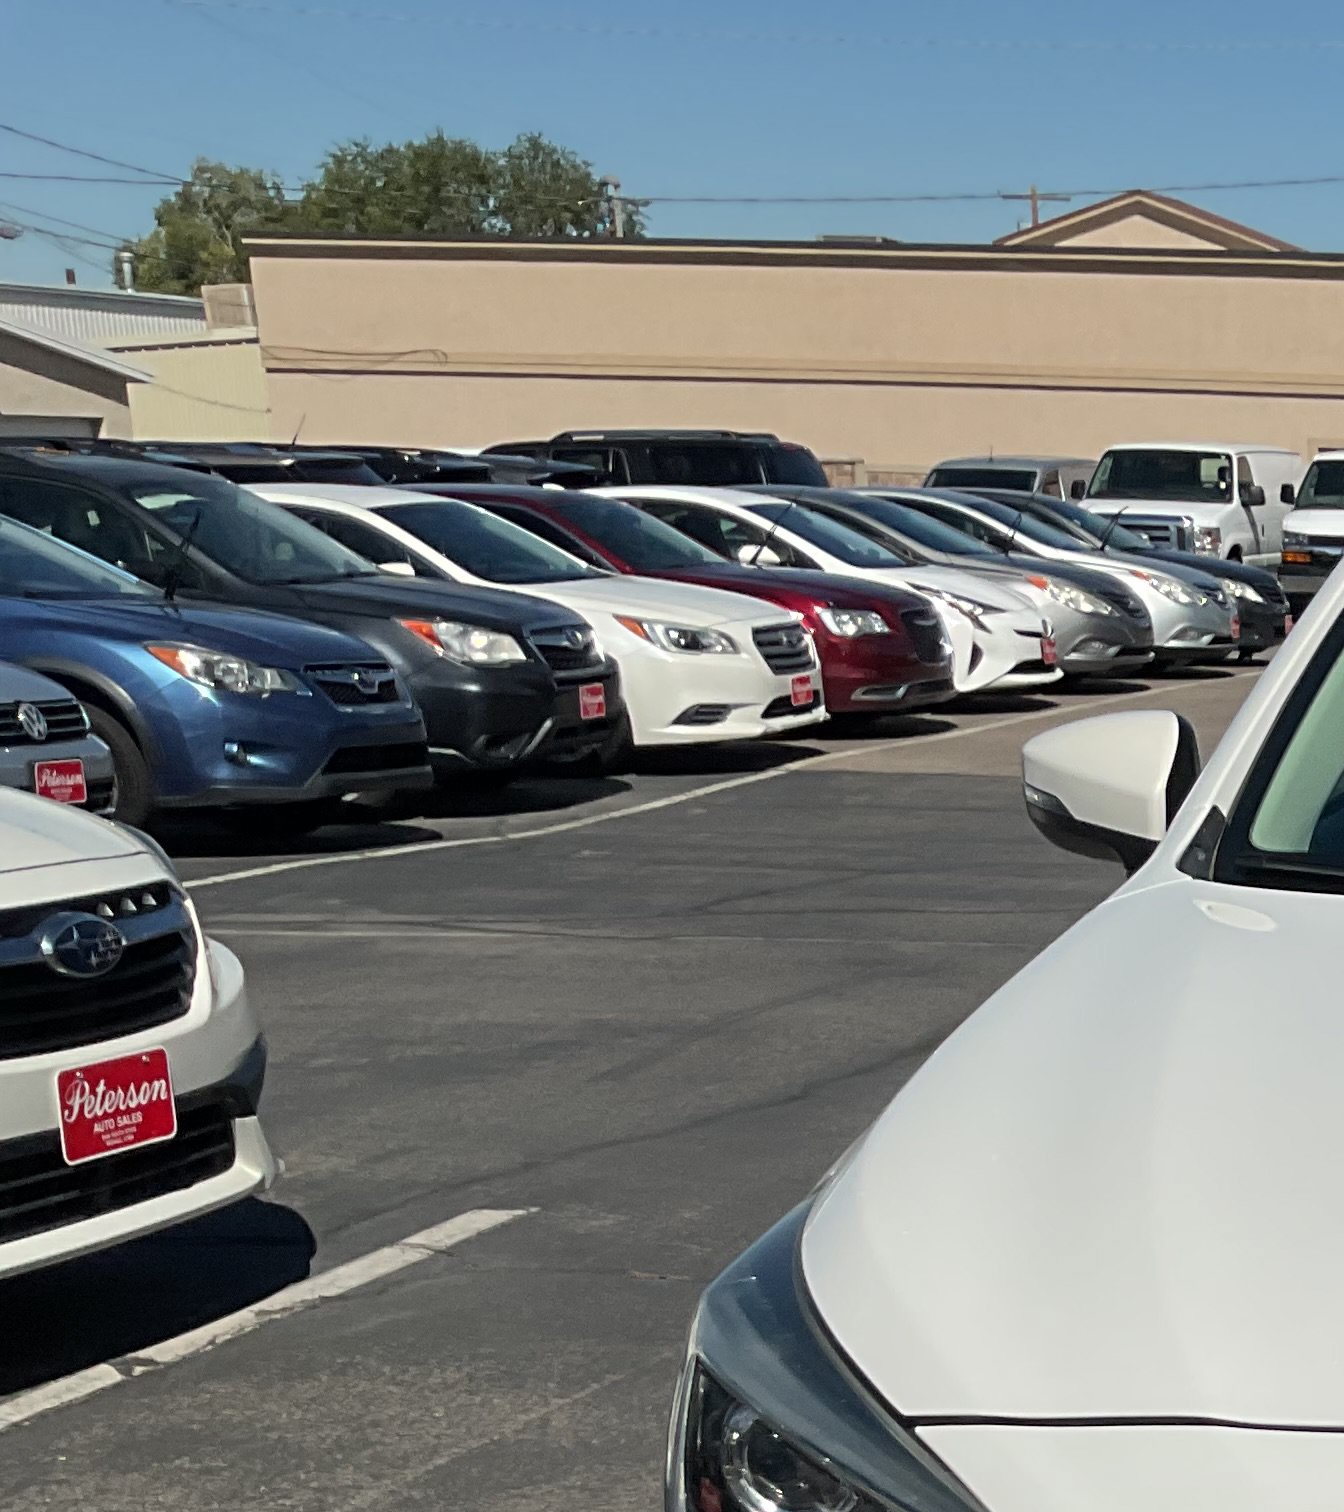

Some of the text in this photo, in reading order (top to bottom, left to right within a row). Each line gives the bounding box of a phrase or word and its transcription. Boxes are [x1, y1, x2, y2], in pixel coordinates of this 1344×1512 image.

[64, 1077, 168, 1123] Peterson
[93, 1111, 143, 1134] AUTO SALES
